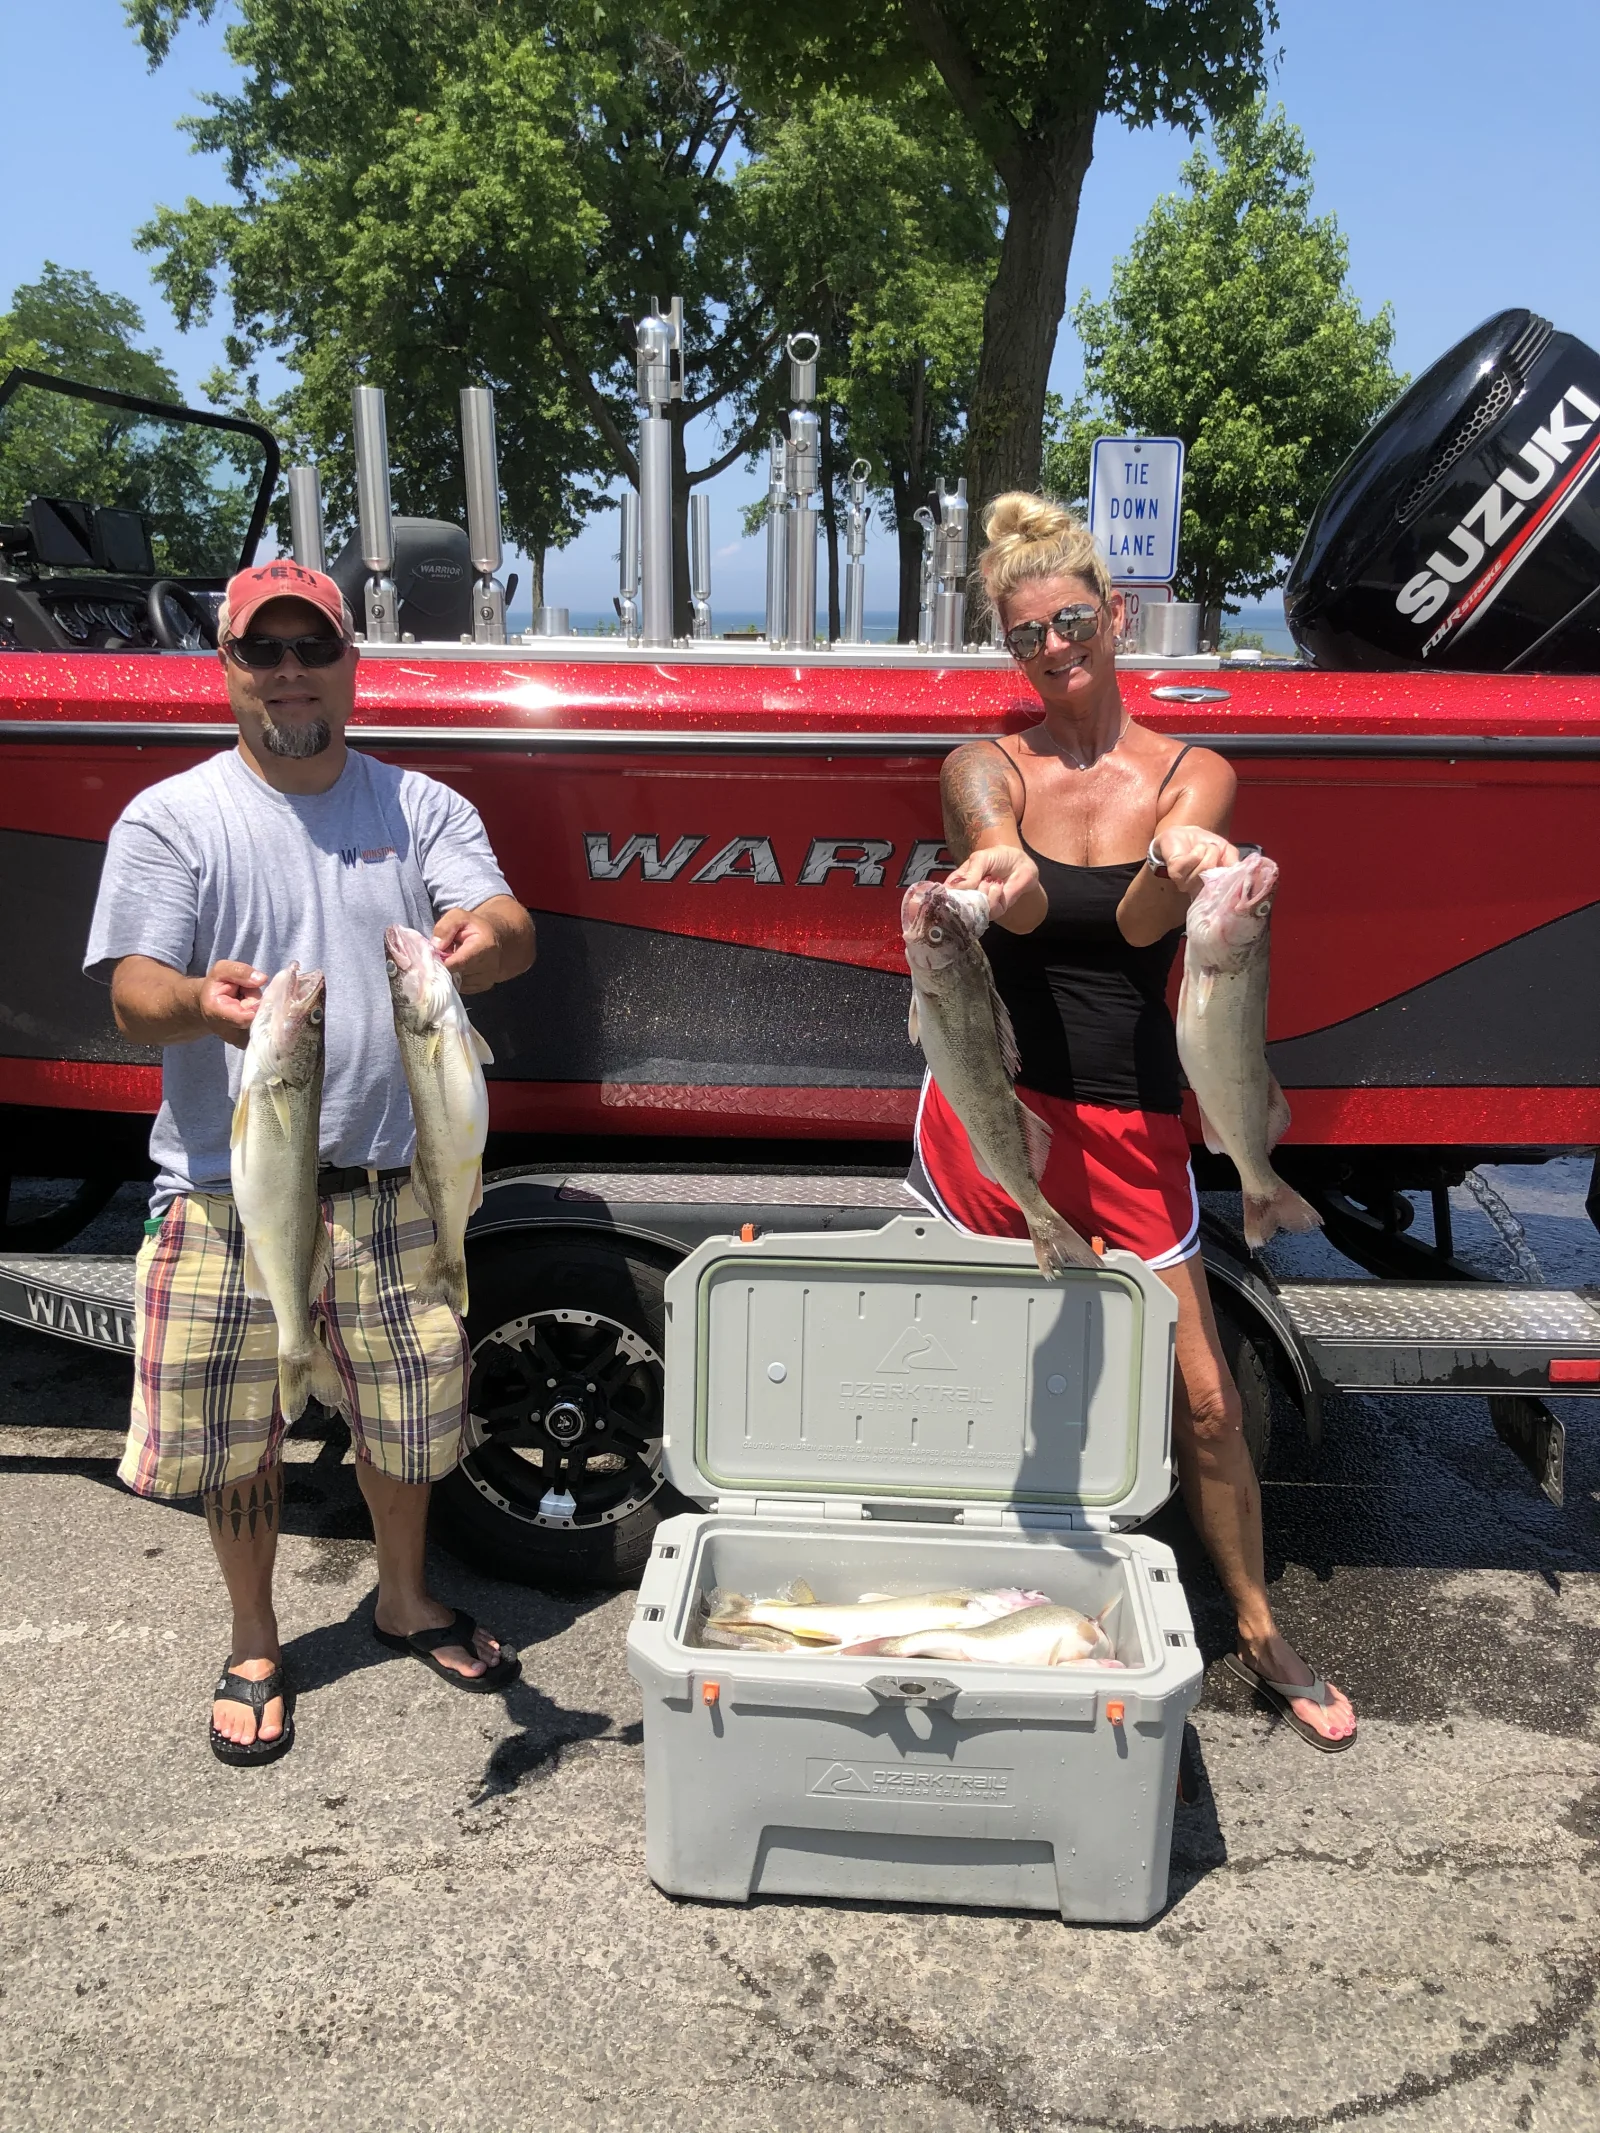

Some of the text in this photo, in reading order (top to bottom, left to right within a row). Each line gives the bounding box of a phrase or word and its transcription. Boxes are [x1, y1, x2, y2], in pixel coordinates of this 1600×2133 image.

[1124, 463, 1149, 485] TIE
[1110, 498, 1159, 520] DOWN
[1395, 385, 1600, 624] SUZUKI
[1109, 534, 1156, 557] LANE
[252, 566, 317, 585] YETI
[420, 565, 461, 576] WARRIOR
[839, 1401, 994, 1416] OUTDOOR EQUIPMENT
[818, 1444, 833, 1452] AND
[836, 1445, 854, 1453] PETS
[856, 1445, 871, 1454] CAN
[906, 1448, 939, 1457] TRAPPED
[960, 1450, 976, 1459] CAN
[872, 1786, 1007, 1799] OUTDOOR EQUIPMENT
